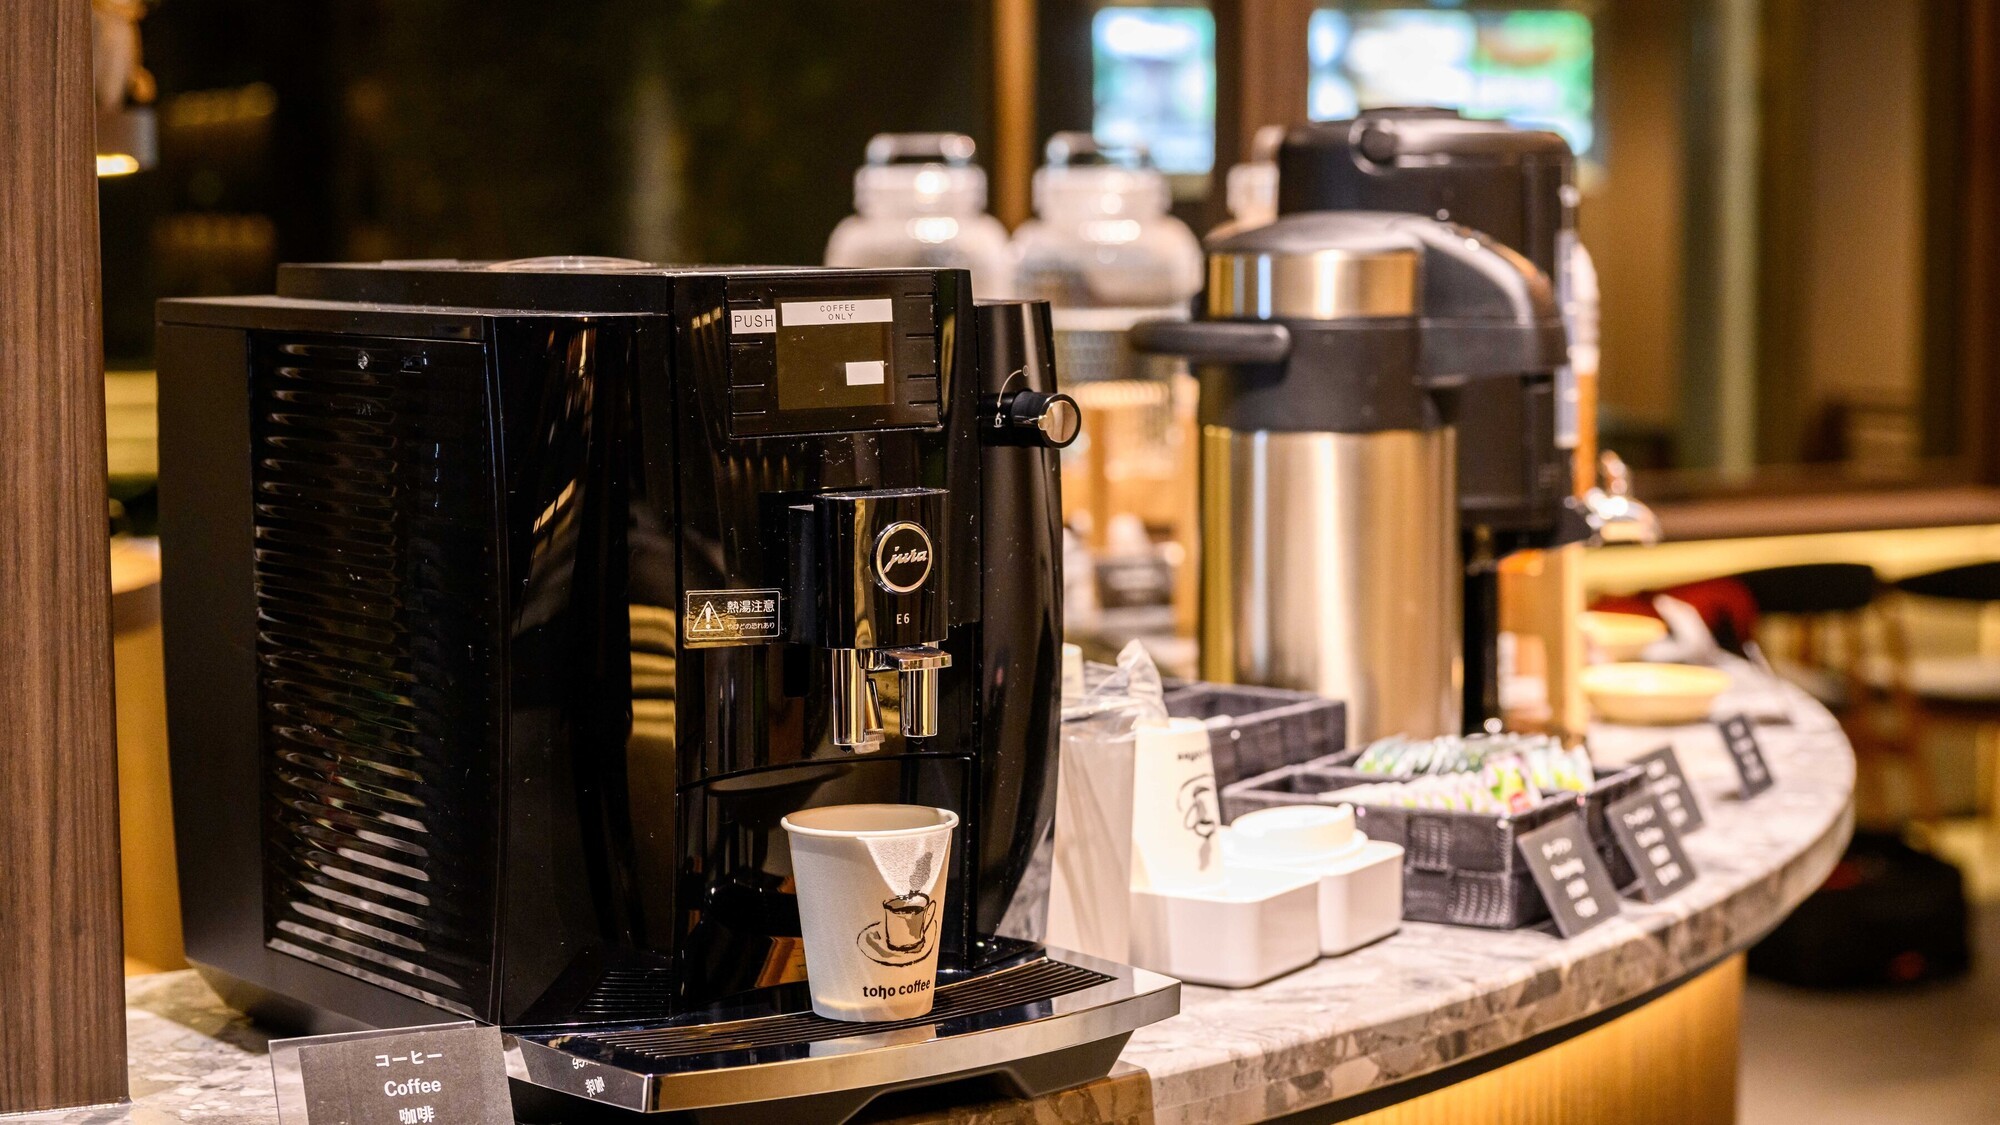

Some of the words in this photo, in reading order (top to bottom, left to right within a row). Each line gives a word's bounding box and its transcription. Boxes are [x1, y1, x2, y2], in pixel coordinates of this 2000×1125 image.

[820, 304, 856, 313] COFFEE
[828, 312, 854, 321] ONLY
[733, 314, 775, 329] PUSH
[882, 545, 928, 575] jura
[726, 599, 776, 614] 熱湯注意
[727, 621, 776, 631] やけどの恐れあり
[862, 985, 896, 1000] toho
[898, 979, 931, 994] coffee
[374, 1050, 443, 1068] コーヒー
[384, 1077, 442, 1098] Coffee
[398, 1105, 436, 1125] 咖啡
